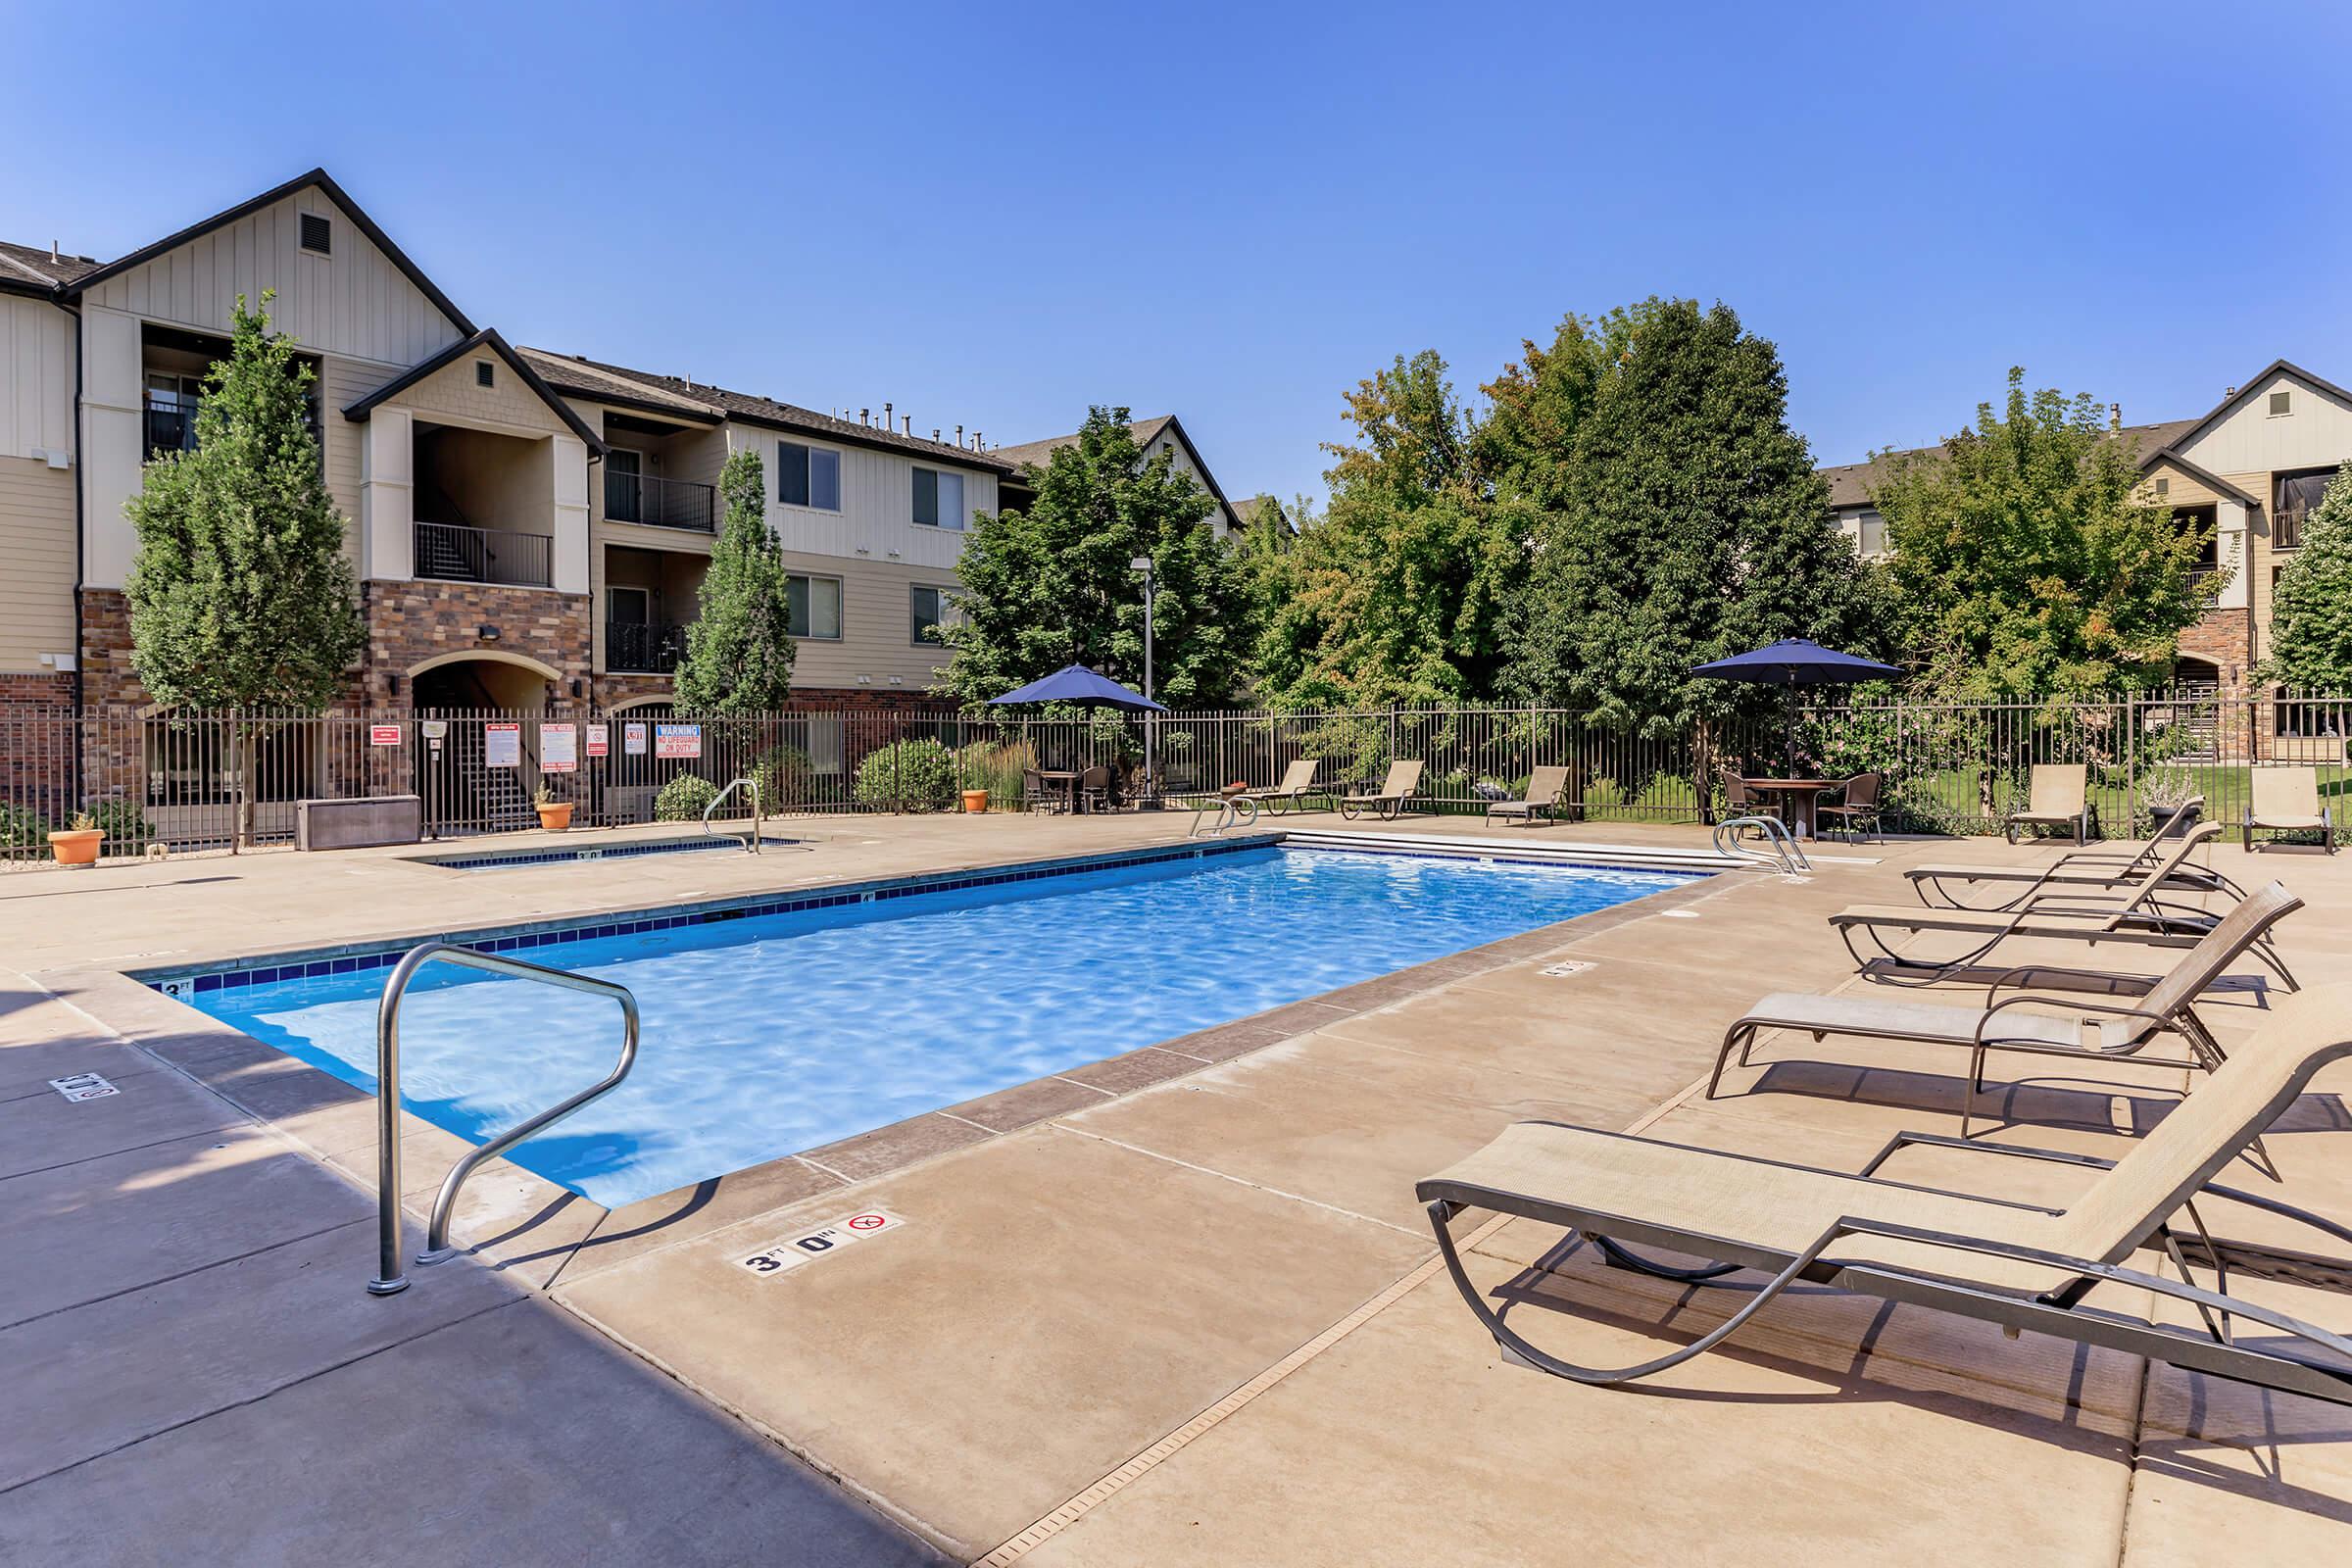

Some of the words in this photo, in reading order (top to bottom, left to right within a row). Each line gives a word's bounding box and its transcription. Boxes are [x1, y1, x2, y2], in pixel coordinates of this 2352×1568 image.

[661, 726, 697, 736] WARNING
[746, 1256, 781, 1272] 3
[766, 1248, 785, 1257] FT
[796, 1237, 834, 1251] 0
[817, 1229, 836, 1239] IN
